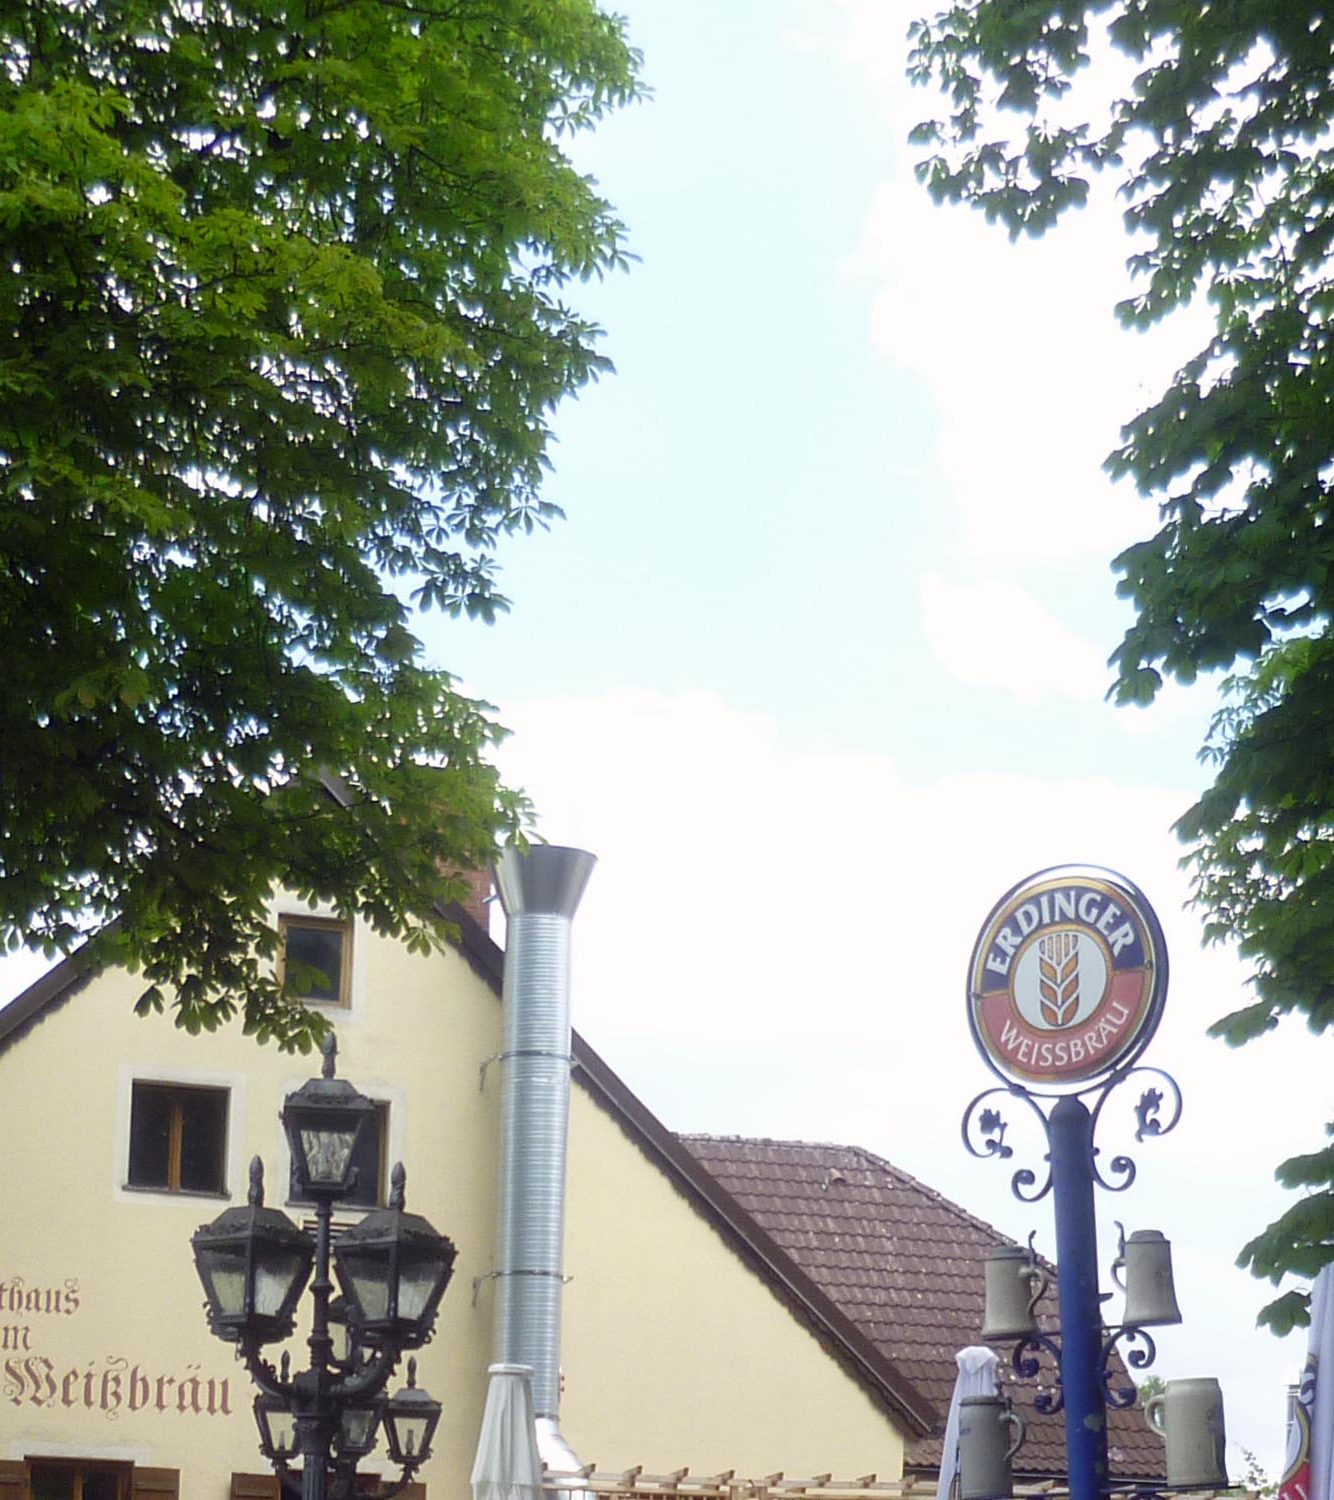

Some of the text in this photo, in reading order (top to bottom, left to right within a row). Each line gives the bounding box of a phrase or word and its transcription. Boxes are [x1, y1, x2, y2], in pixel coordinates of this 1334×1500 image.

[986, 890, 1134, 976] ERDINGER
[1000, 1002, 1130, 1067] WEISSBRÄU
[3, 1355, 233, 1421] Weißbräu
